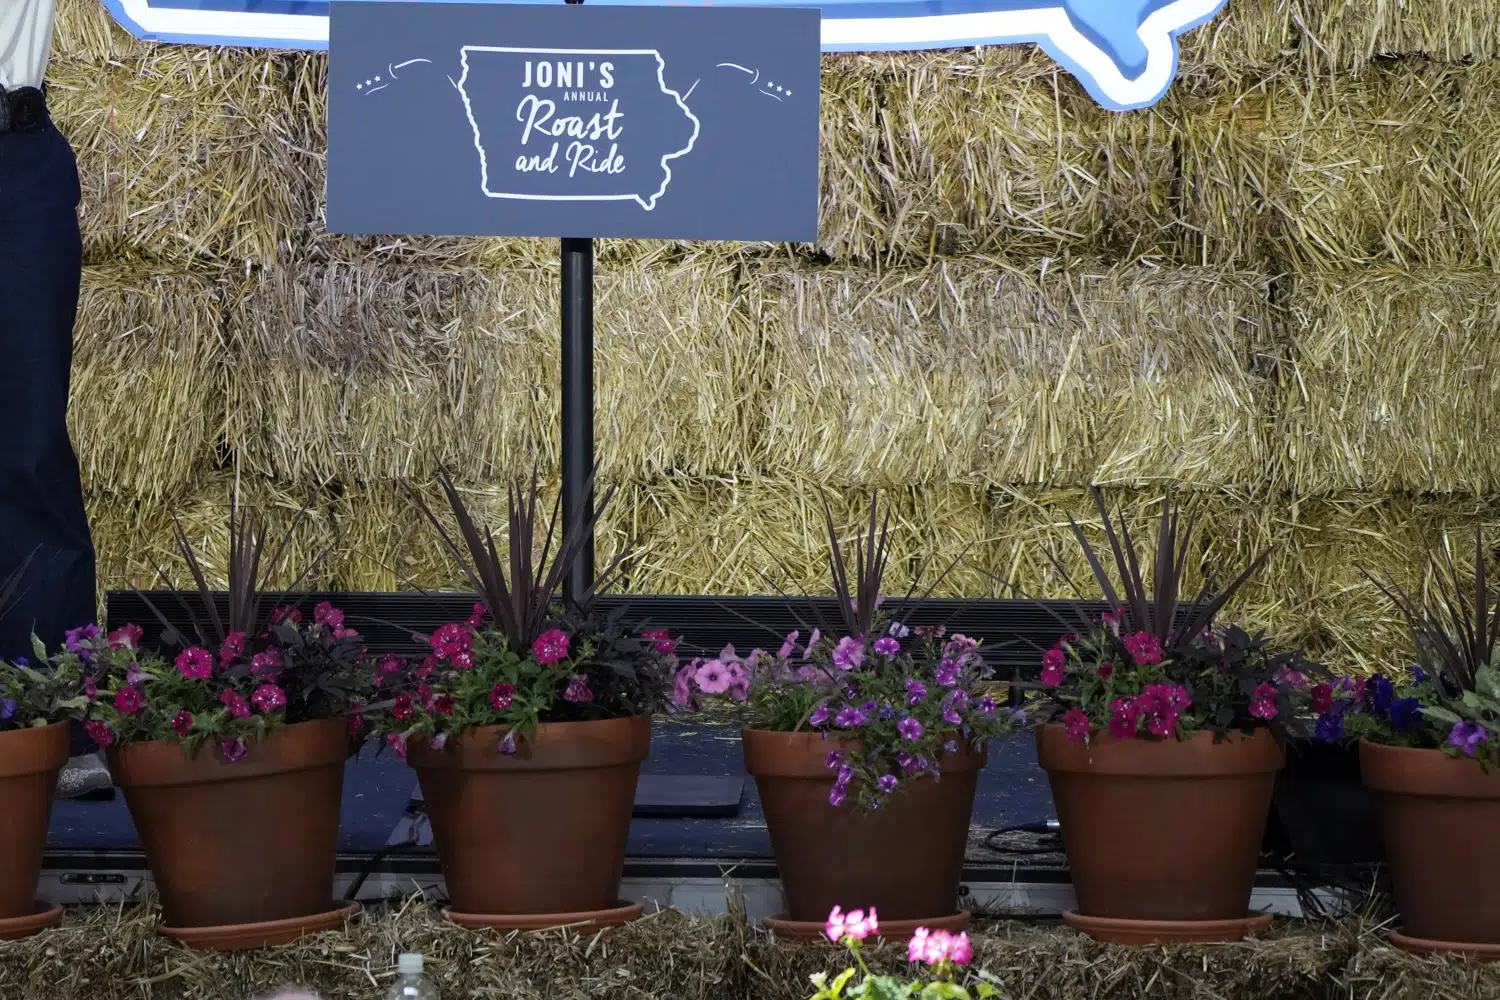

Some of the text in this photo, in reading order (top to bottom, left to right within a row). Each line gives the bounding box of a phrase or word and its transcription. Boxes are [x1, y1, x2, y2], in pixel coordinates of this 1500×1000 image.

[522, 61, 615, 88] JONI'S
[563, 91, 609, 102] ANNUAL
[516, 94, 624, 145] Roast
[515, 141, 626, 178] and Ride
